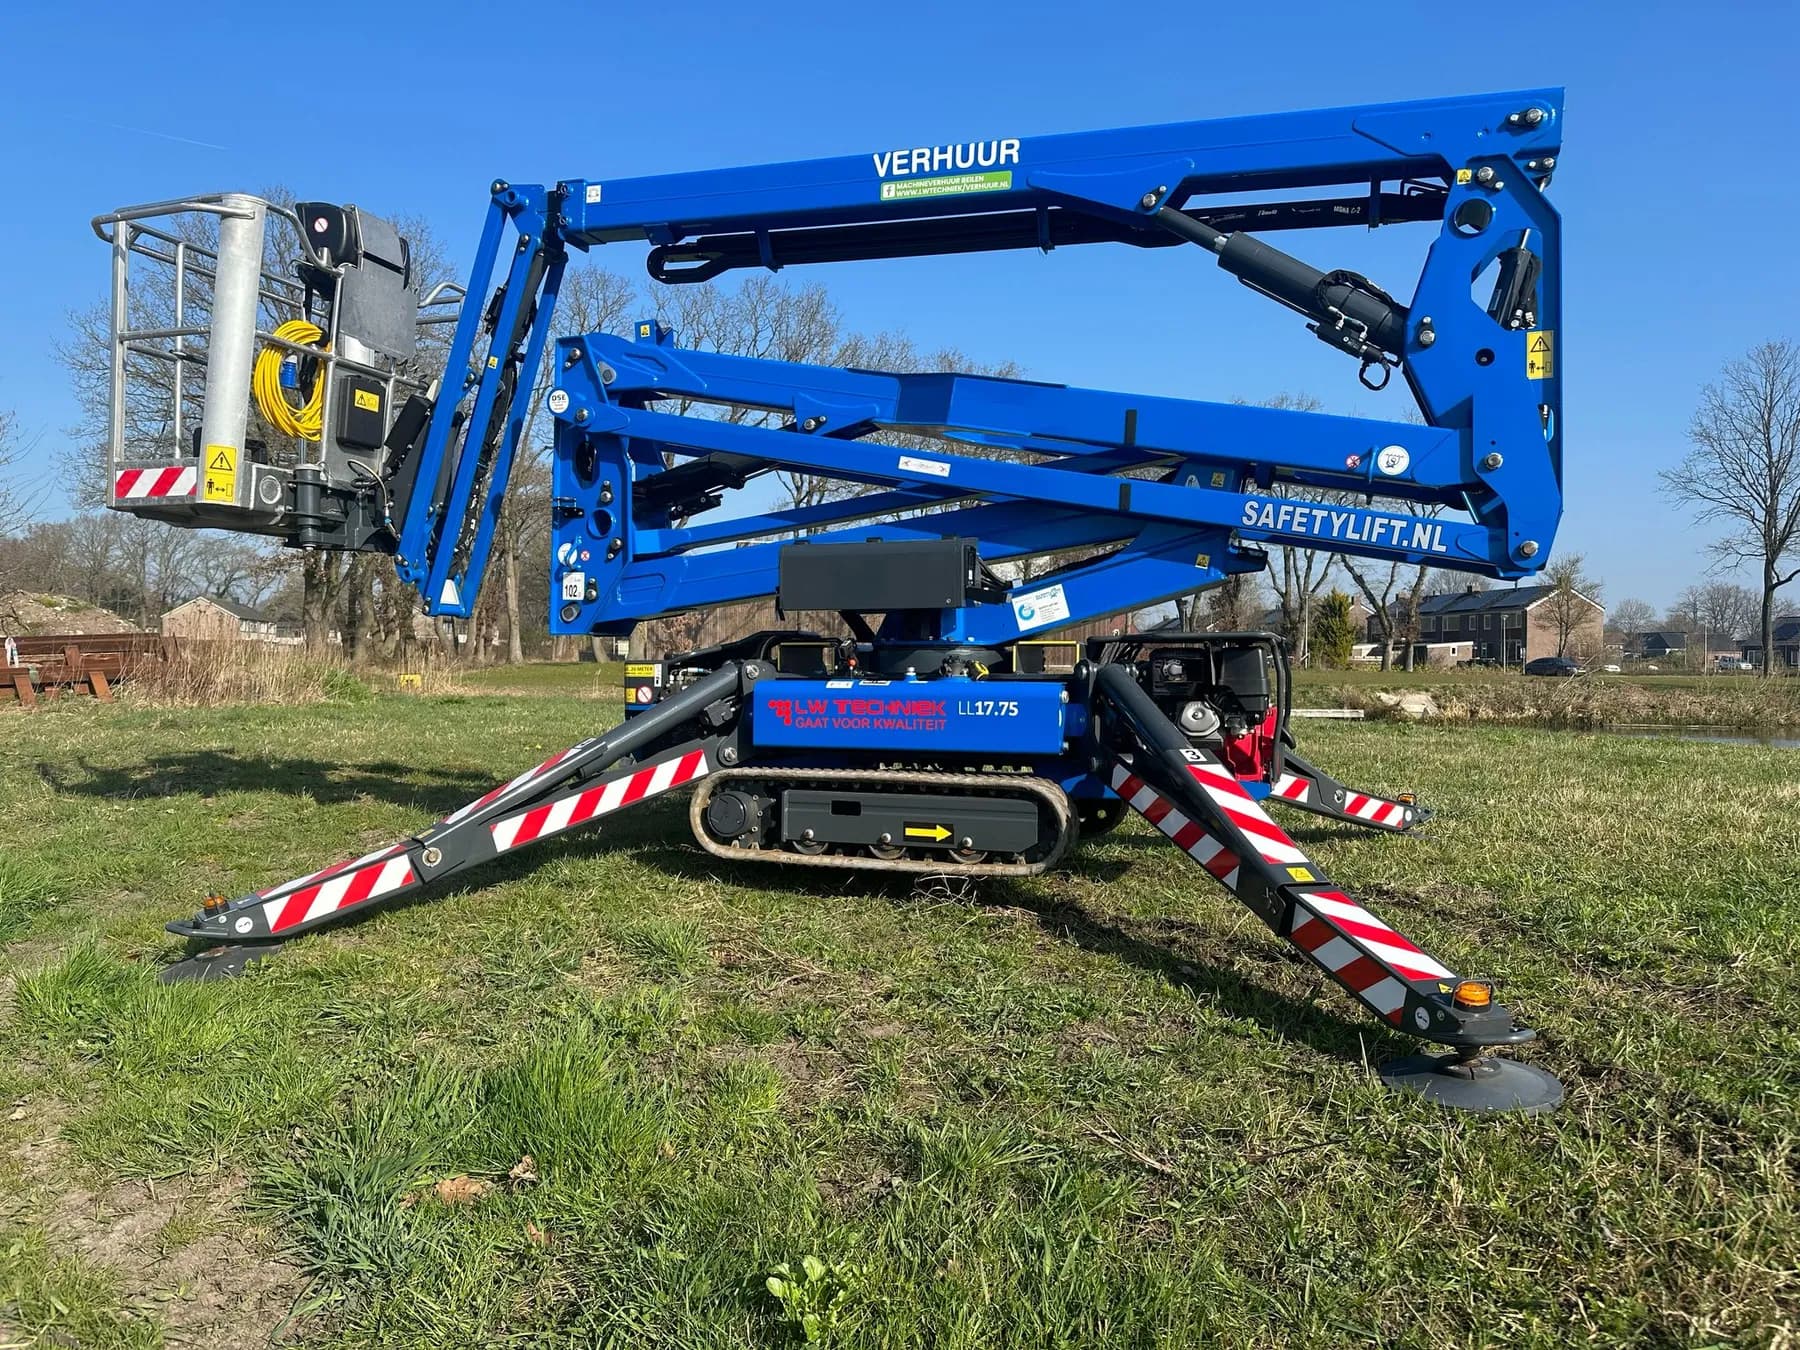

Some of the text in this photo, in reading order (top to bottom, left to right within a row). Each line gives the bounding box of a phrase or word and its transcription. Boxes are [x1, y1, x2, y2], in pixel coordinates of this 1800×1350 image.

[873, 138, 1021, 177] VERHUUR
[896, 177, 961, 189] MACHINEVERHUUR
[1241, 500, 1448, 553] SAFETYLIFT.NL
[565, 584, 578, 597] 102
[795, 700, 947, 716] LW TECHNIEK
[958, 701, 1019, 716] LL17.75
[795, 717, 947, 731] GAAT VOOR KWALITEIT
[1185, 750, 1201, 760] 3
